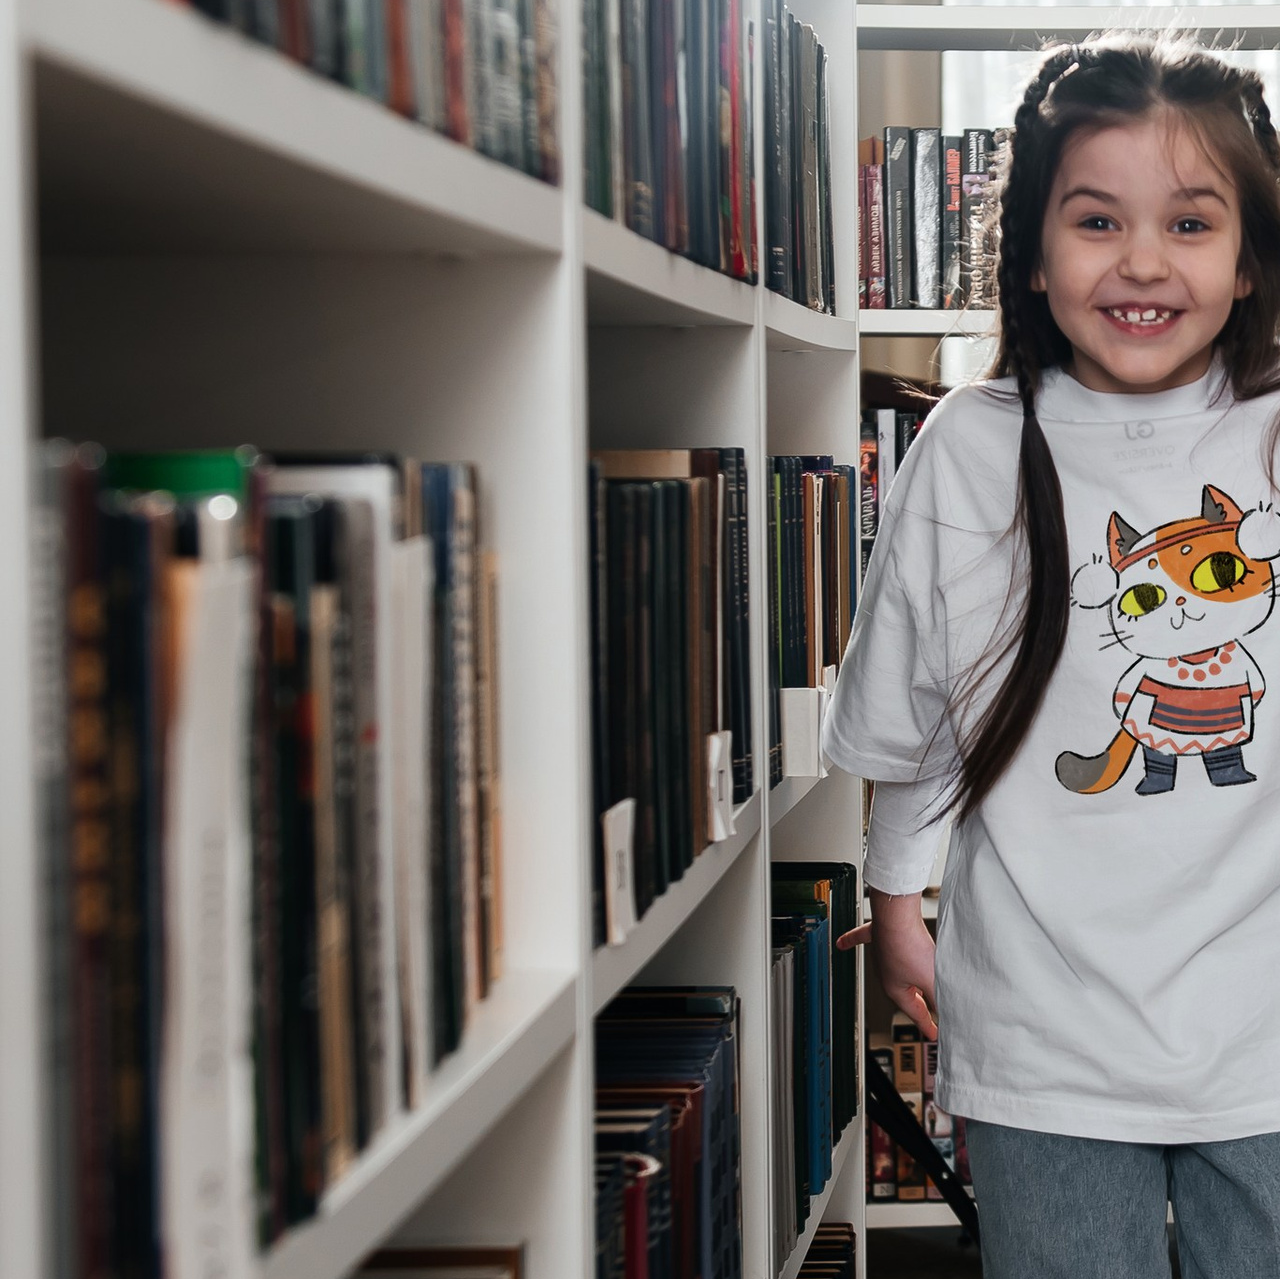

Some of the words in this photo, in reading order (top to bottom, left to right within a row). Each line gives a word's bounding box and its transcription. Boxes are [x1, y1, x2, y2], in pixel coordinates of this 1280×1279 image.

[869, 204, 880, 243] АЗИМОВ
[870, 244, 881, 273] АЙЗЕК
[861, 486, 876, 539] КАРАВАЛЬ
